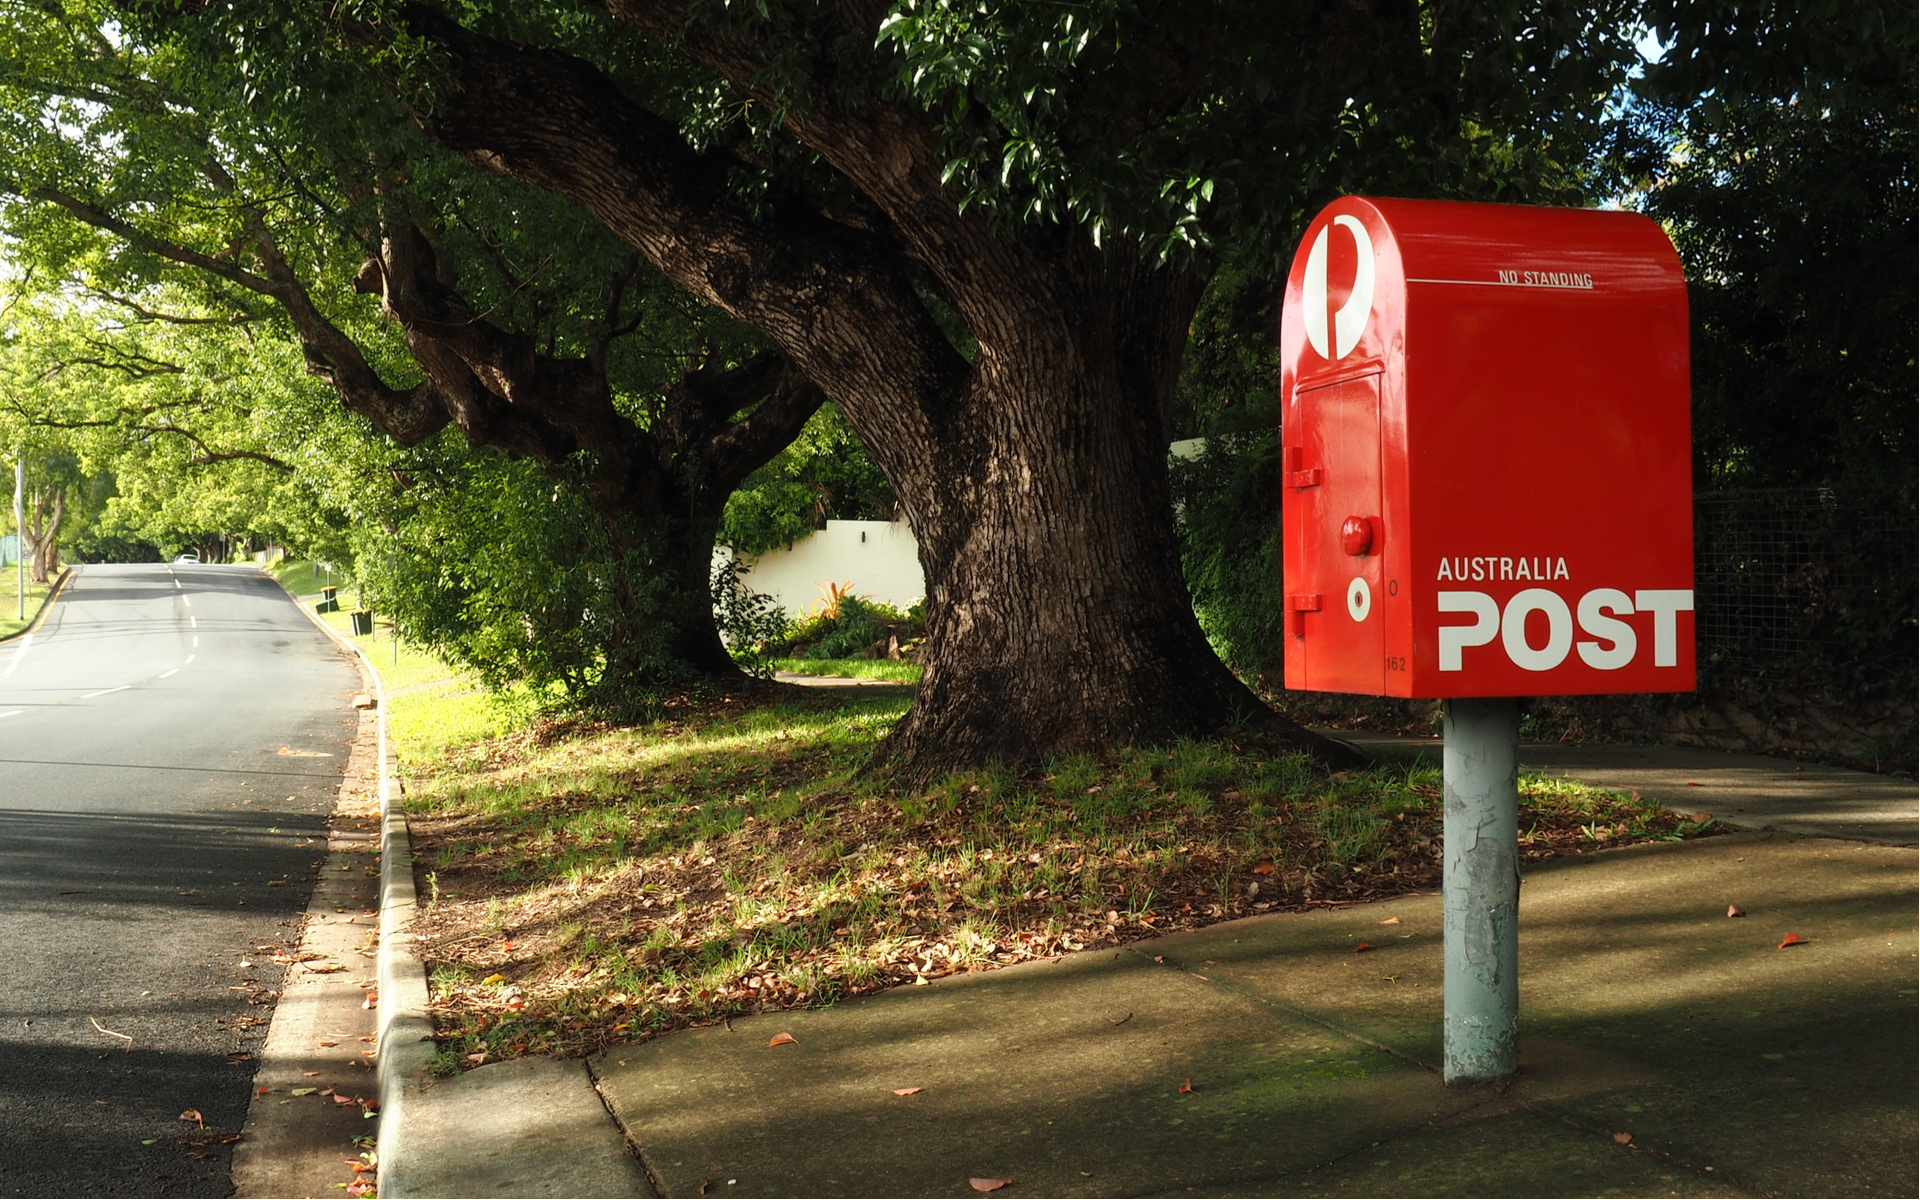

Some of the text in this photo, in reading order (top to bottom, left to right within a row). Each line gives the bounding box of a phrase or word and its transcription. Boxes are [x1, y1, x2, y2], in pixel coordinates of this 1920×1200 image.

[1499, 270, 1592, 288] NO STANDING
[1437, 557, 1570, 581] AUSTRALIA
[1437, 588, 1694, 671] POST
[1386, 657, 1406, 671] 162
